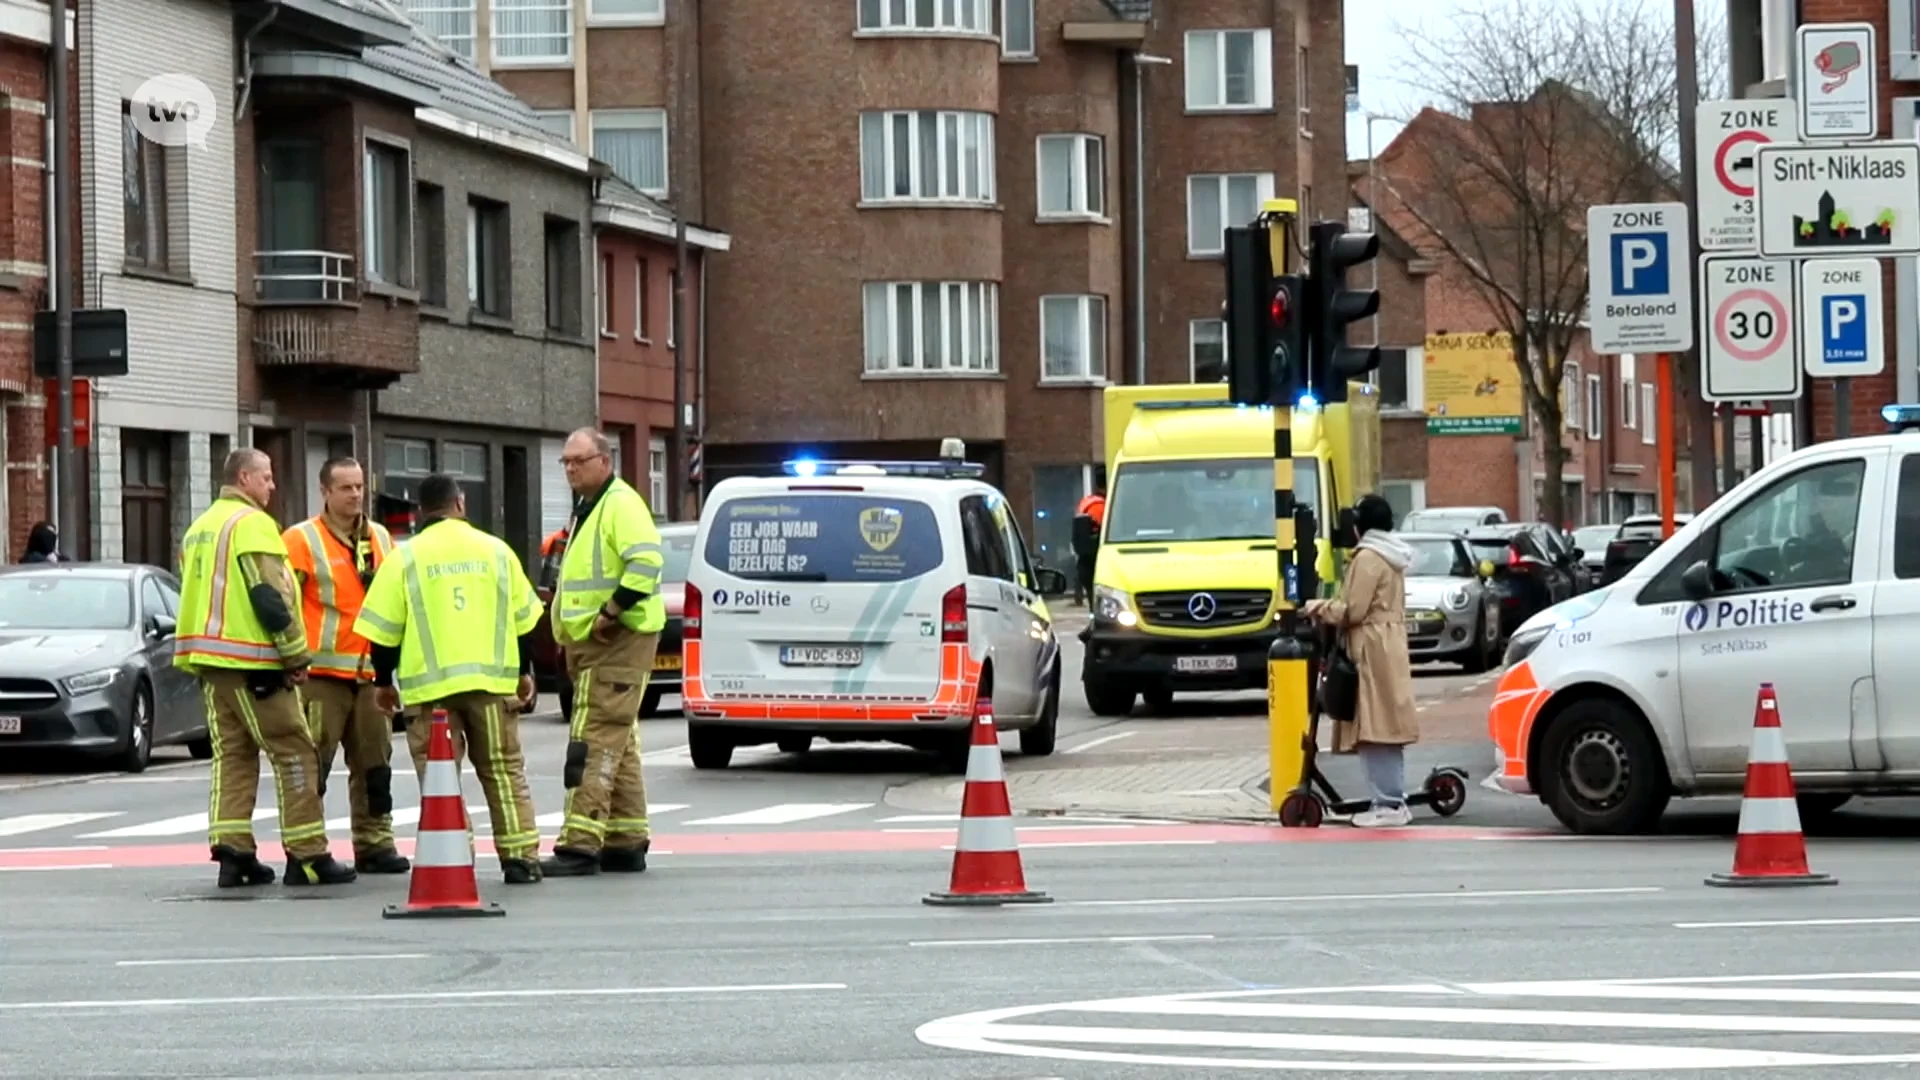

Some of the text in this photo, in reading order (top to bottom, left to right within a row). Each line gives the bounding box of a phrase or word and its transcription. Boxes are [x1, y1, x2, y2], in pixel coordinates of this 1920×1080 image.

[1721, 110, 1778, 128] ZONE
[1774, 155, 1906, 181] Sint-Niklaas
[1612, 211, 1664, 228] ZONE
[1622, 239, 1657, 289] P
[1724, 266, 1775, 283] ZONE
[1822, 271, 1862, 284] ZONE
[1606, 302, 1677, 318] Betalend
[1730, 311, 1773, 339] 30
[1830, 300, 1857, 339] P
[730, 520, 818, 538] EEN JOB WAAR
[729, 538, 787, 555] GEEN DAG
[728, 554, 808, 572] DEZELFDE IS?
[453, 586, 466, 611] 5
[734, 590, 792, 607] Politie
[1716, 597, 1805, 628] Politie
[1572, 631, 1592, 645] 101
[1701, 639, 1768, 656] Sint-Niklaas
